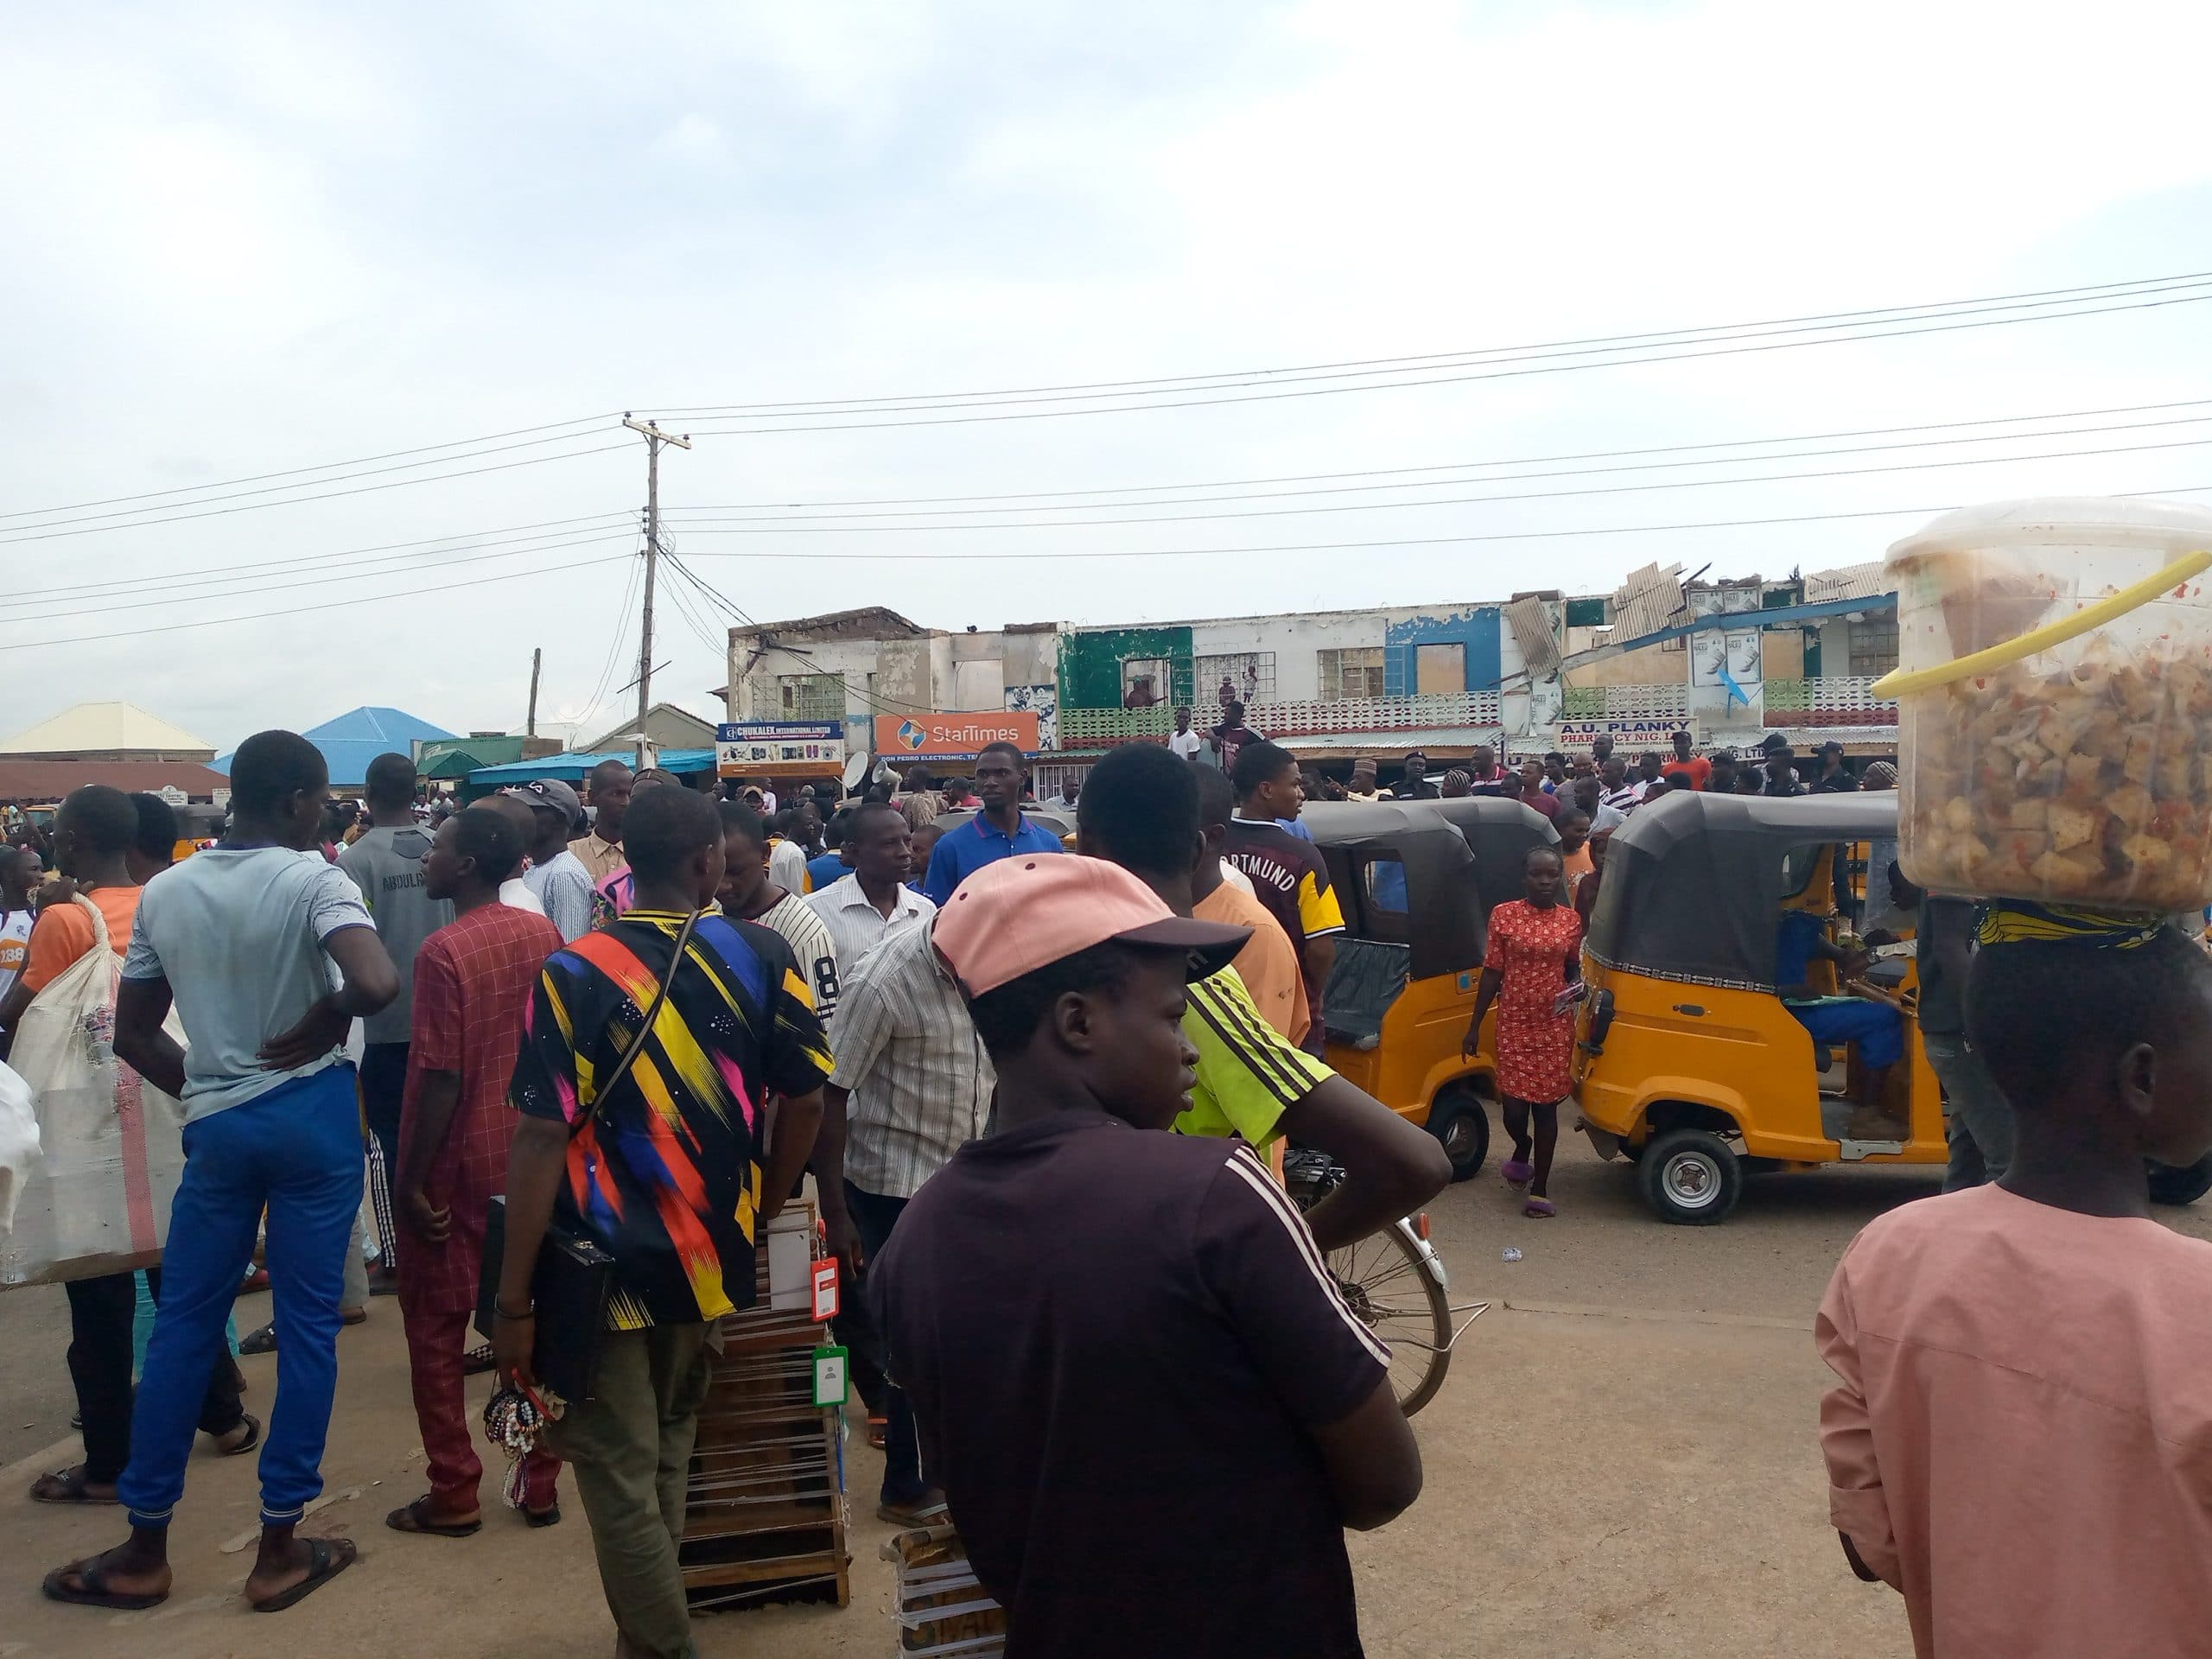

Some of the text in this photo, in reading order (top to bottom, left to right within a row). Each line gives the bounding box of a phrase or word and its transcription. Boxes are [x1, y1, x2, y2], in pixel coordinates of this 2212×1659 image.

[737, 727, 775, 736] CHUKALEX
[932, 725, 1019, 742] StarTimes
[1561, 721, 1690, 734] A.U. PLANKY
[1560, 733, 1632, 743] PHARCY
[1635, 732, 1662, 741] NIG.
[815, 956, 841, 1000] 8
